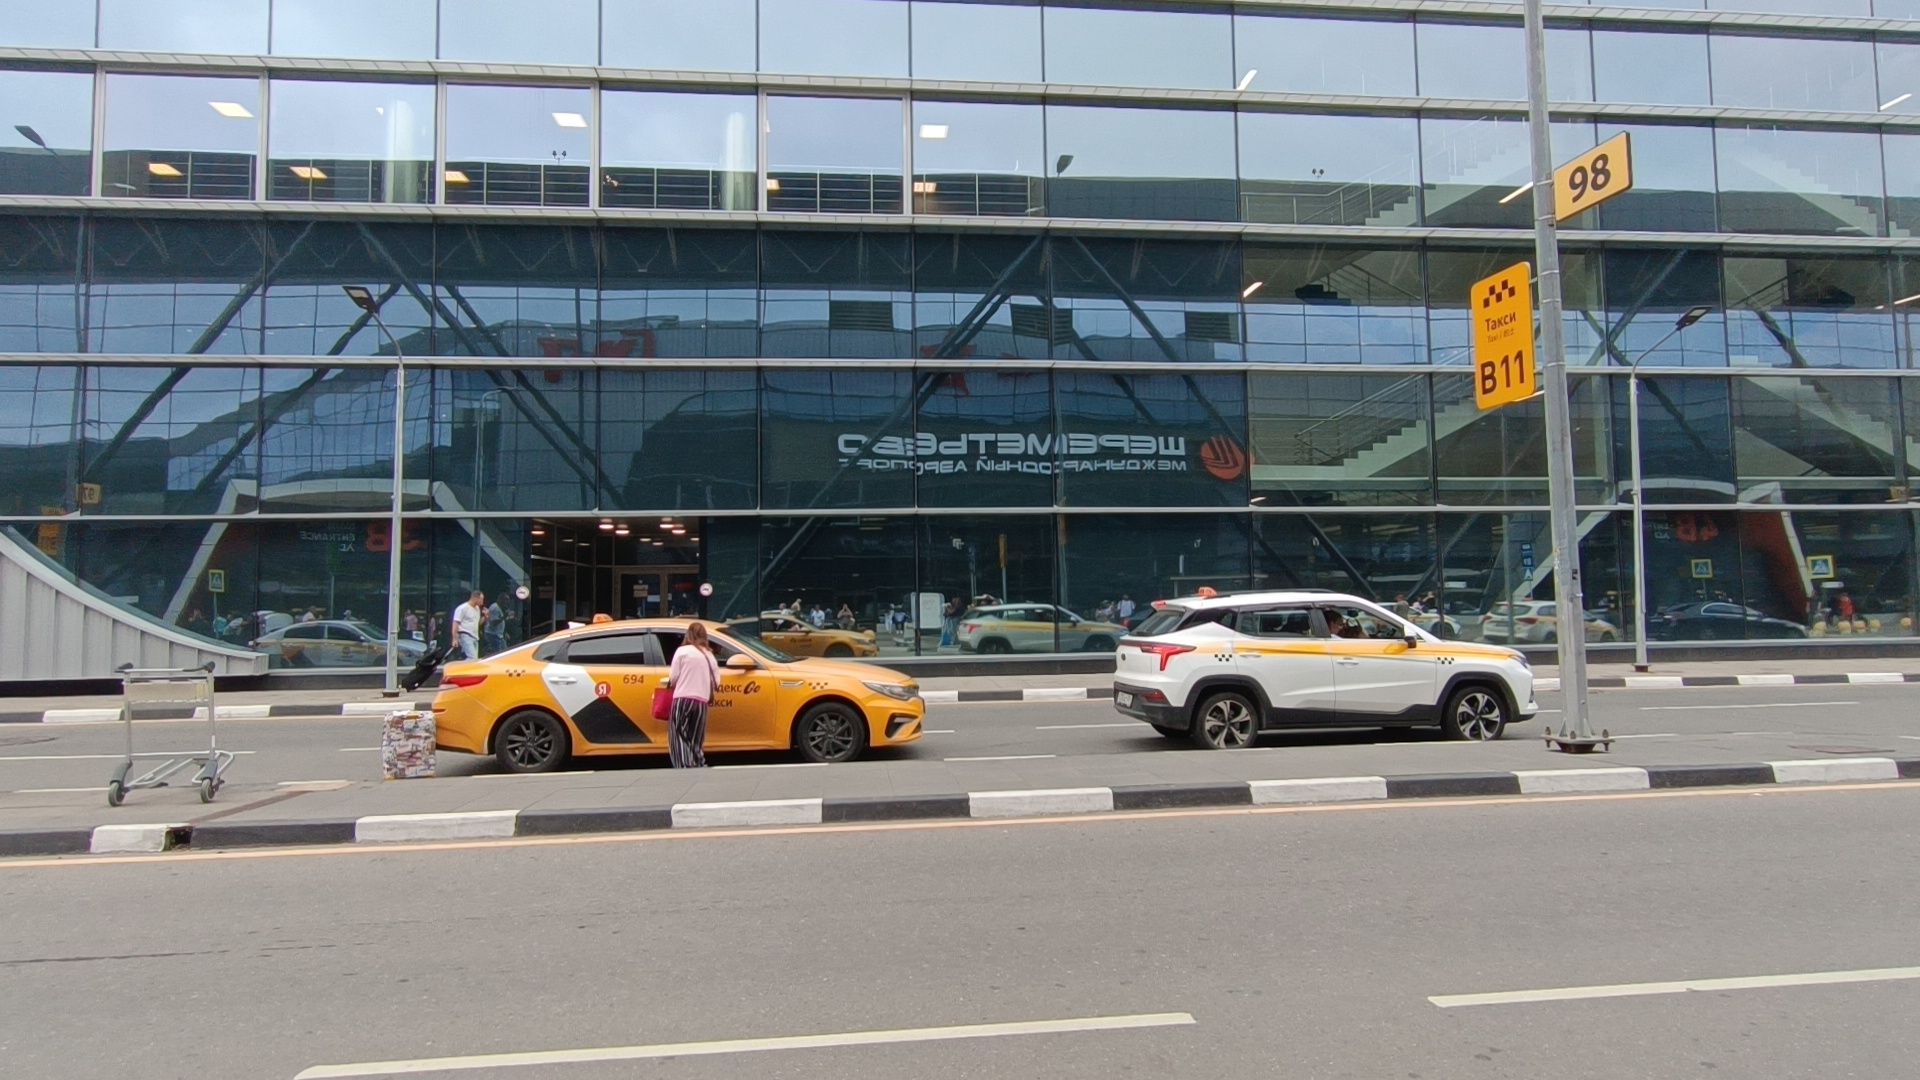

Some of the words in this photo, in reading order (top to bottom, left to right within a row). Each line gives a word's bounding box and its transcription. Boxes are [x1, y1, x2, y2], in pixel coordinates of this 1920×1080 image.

[1568, 153, 1611, 204] 98
[1484, 311, 1517, 332] Такси
[1481, 349, 1525, 396] B11
[623, 674, 645, 685] 694
[598, 683, 608, 696] Я
[743, 680, 761, 695] Go
[707, 699, 733, 708] акси
